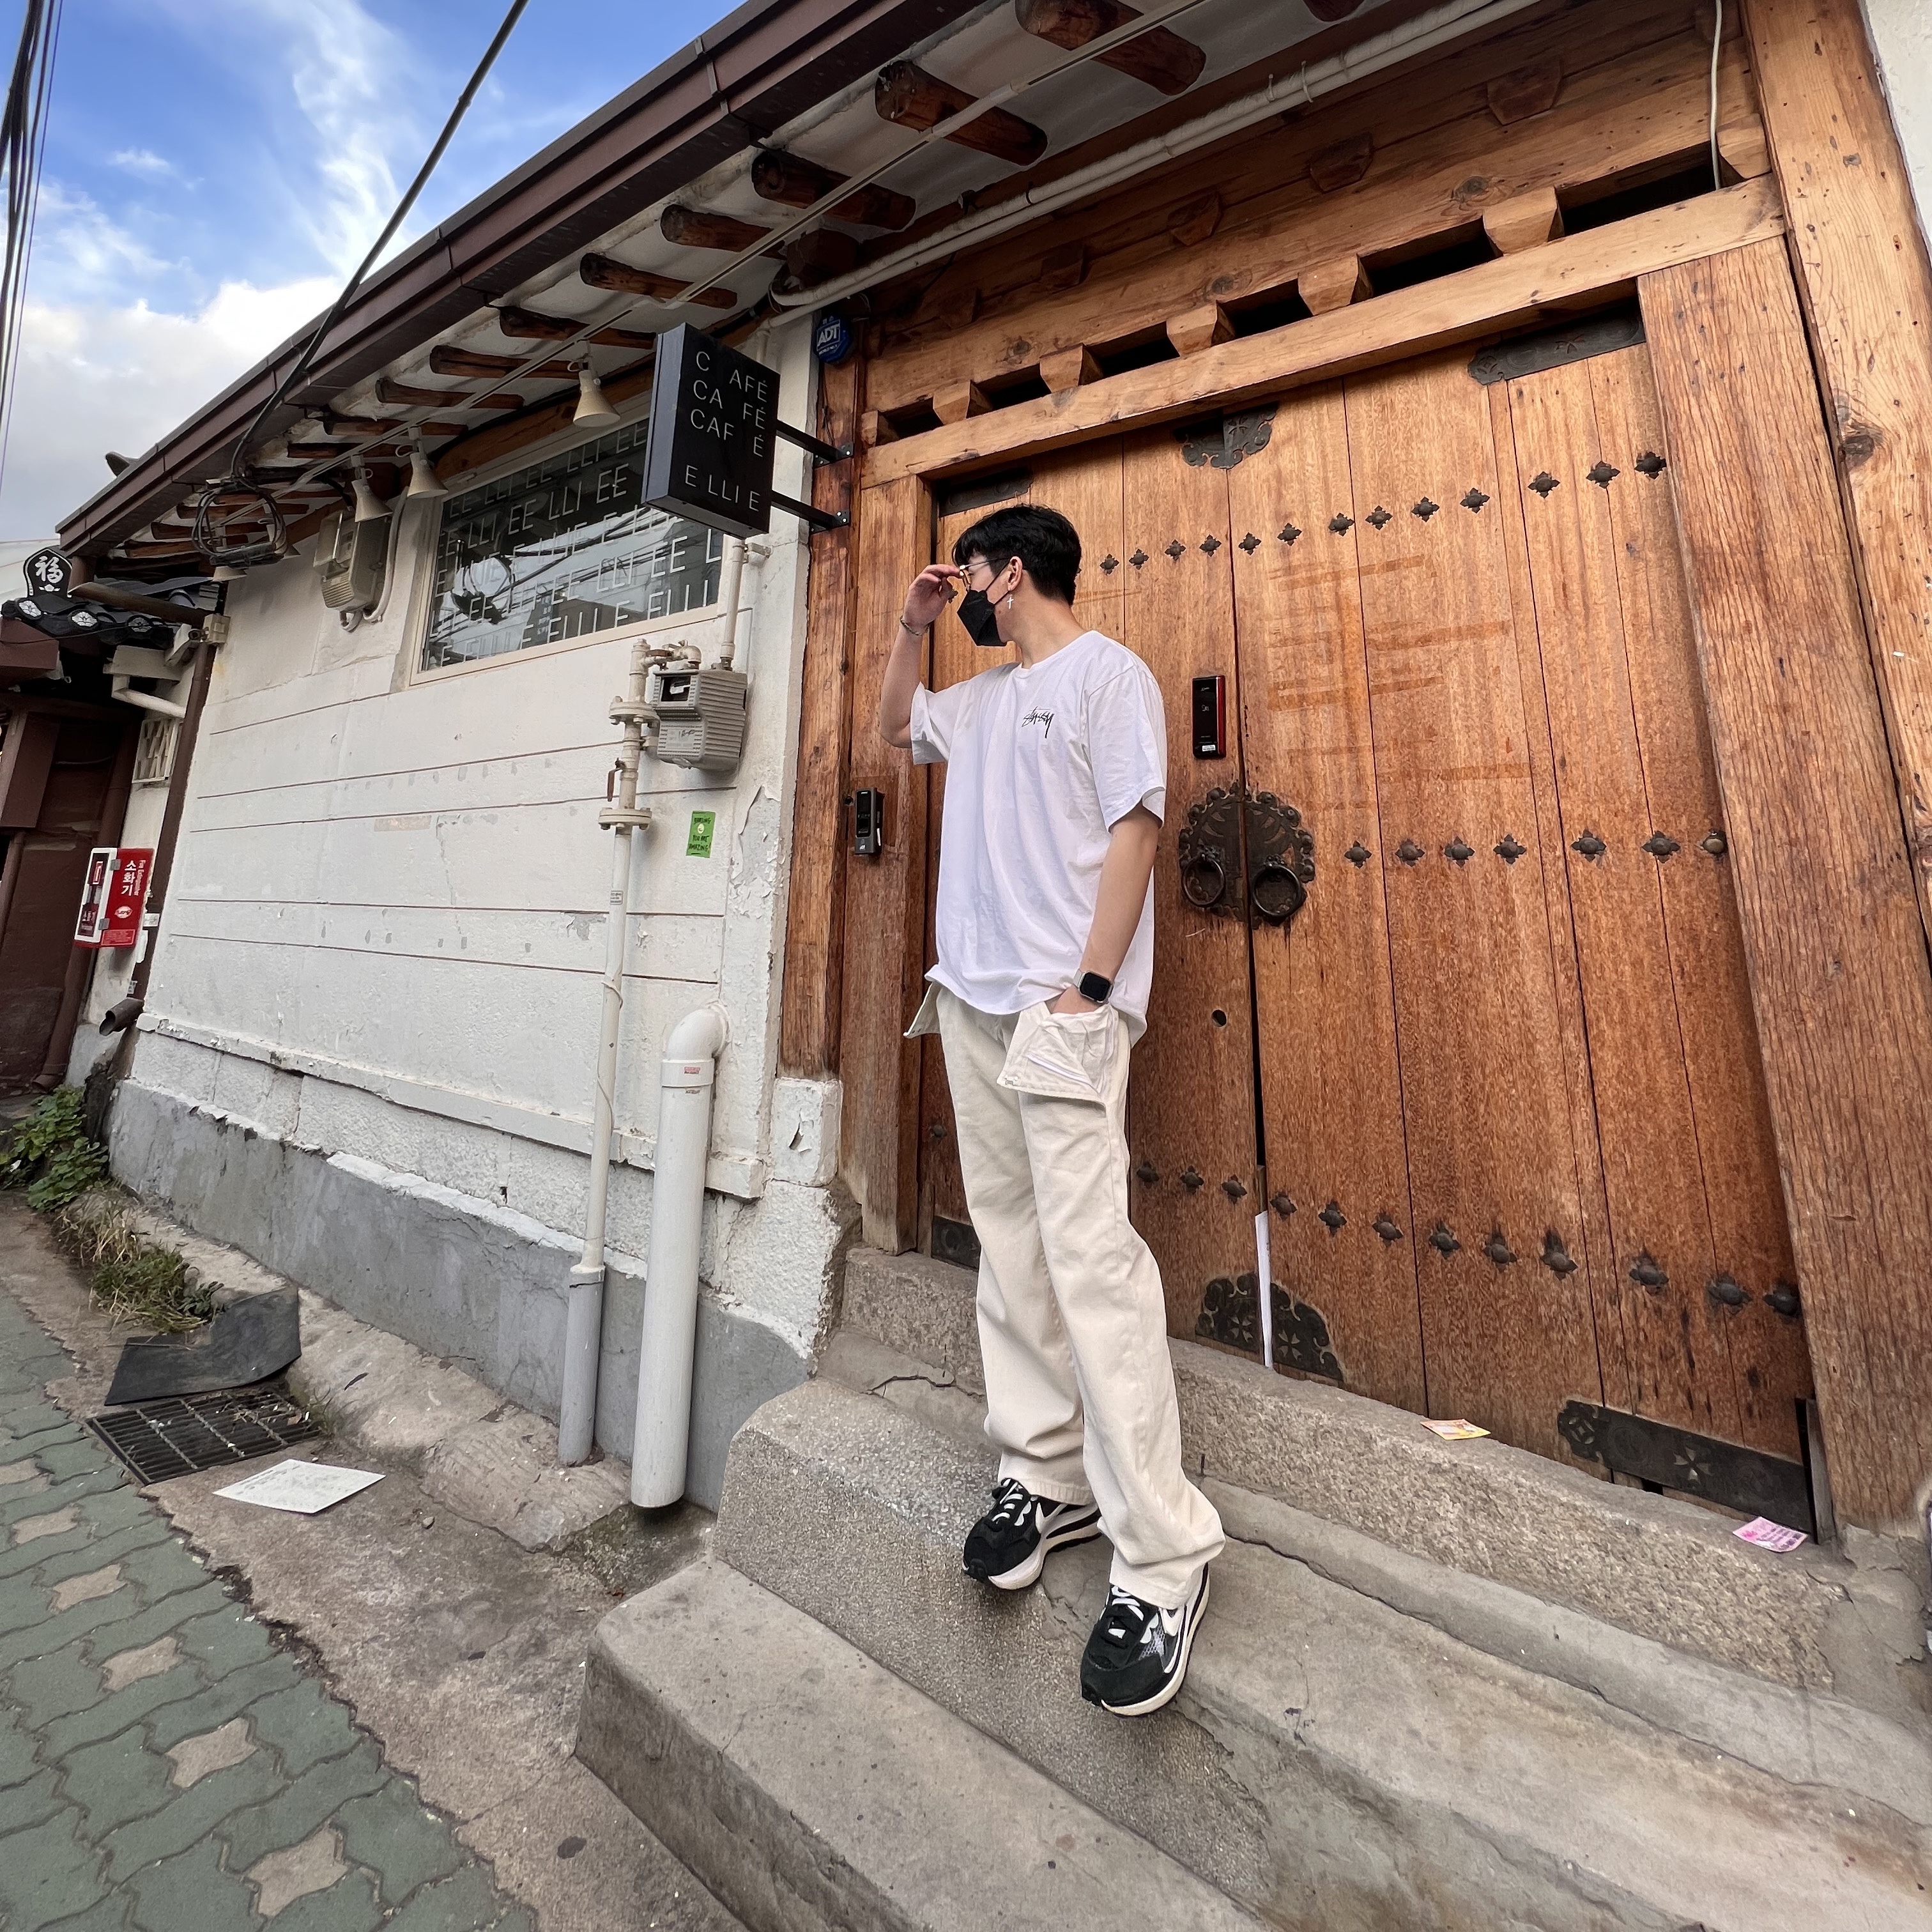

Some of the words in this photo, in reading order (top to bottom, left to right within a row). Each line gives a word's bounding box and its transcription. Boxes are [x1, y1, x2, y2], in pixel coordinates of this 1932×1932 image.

[817, 323, 840, 347] ADT
[691, 409, 734, 440] CAF
[35, 556, 63, 583] 福
[121, 860, 136, 896] 소화기
